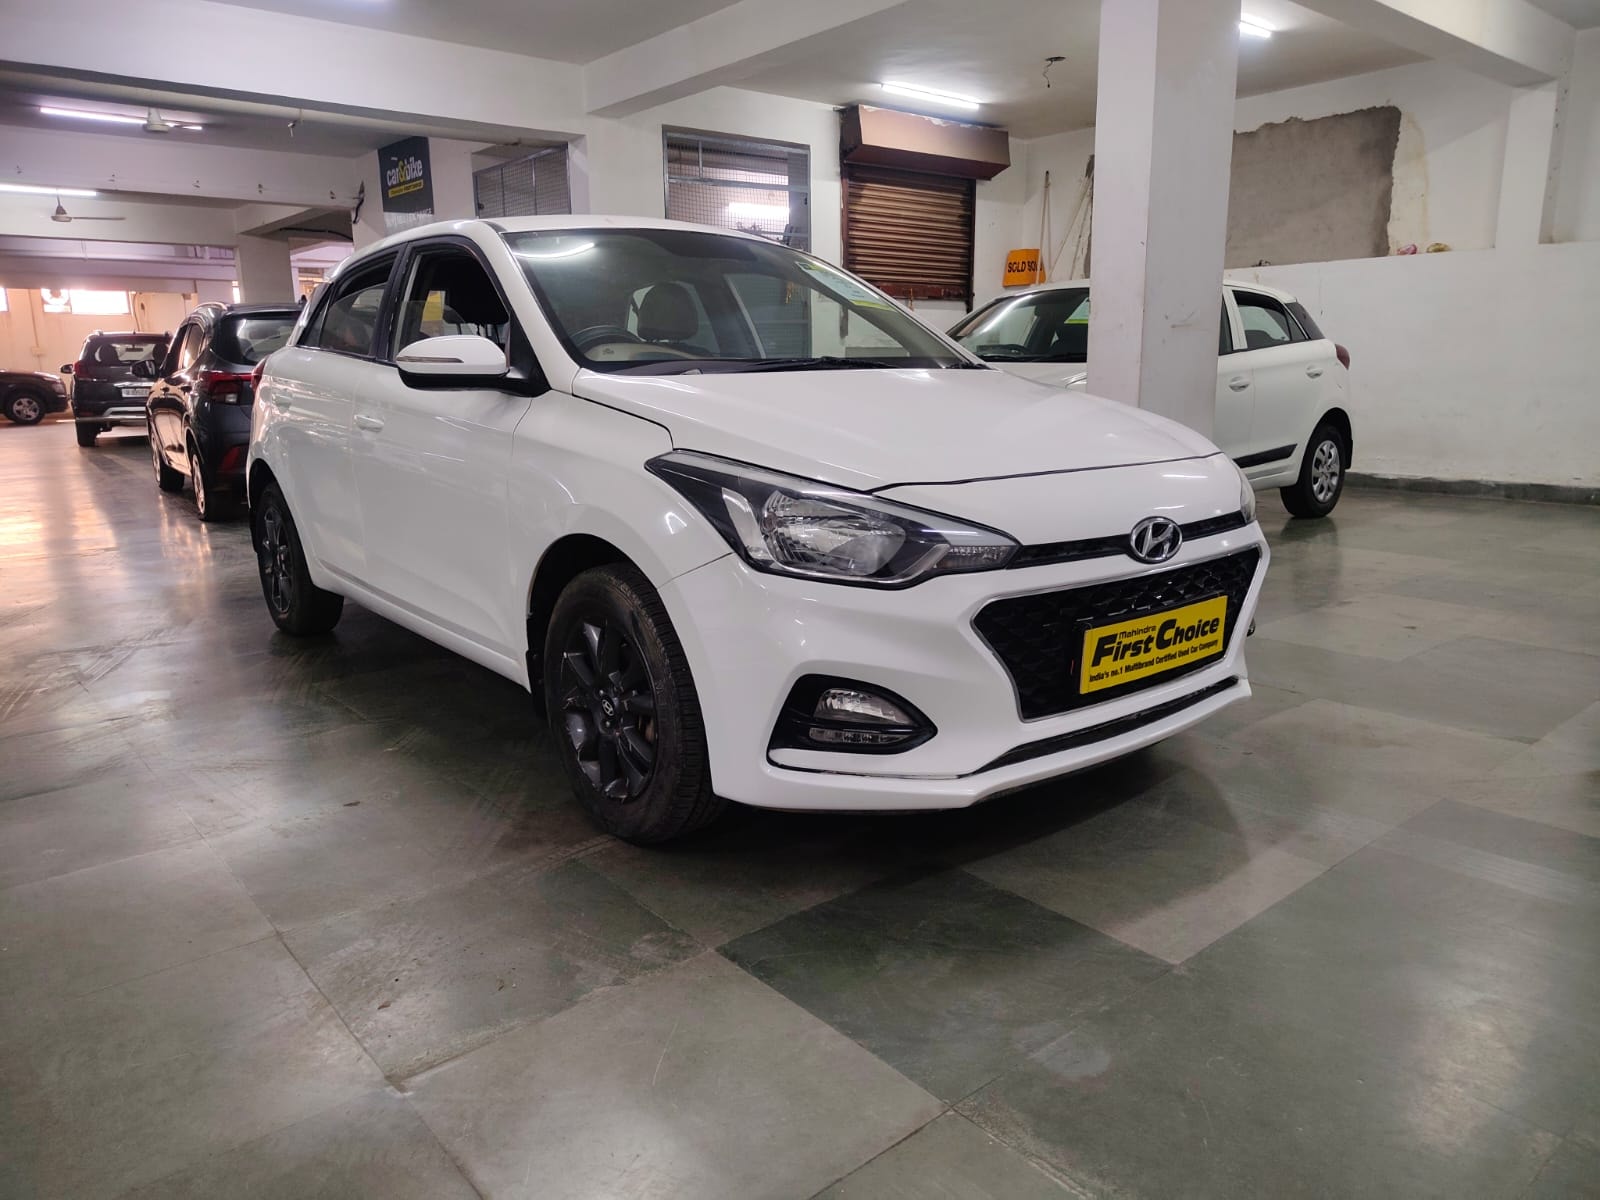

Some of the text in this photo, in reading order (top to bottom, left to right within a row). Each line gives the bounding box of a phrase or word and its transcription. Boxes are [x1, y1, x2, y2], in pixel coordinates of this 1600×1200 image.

[386, 156, 423, 187] car&bike
[1007, 261, 1026, 273] SOLD
[1091, 617, 1220, 667] First Choice
[1118, 625, 1156, 640] Mahindra
[1089, 668, 1110, 682] India's
[1124, 657, 1155, 673] Multibrand
[1155, 651, 1177, 665] Certified
[1178, 648, 1190, 658] Used
[1190, 645, 1198, 654] Car
[1198, 639, 1219, 653] Company
